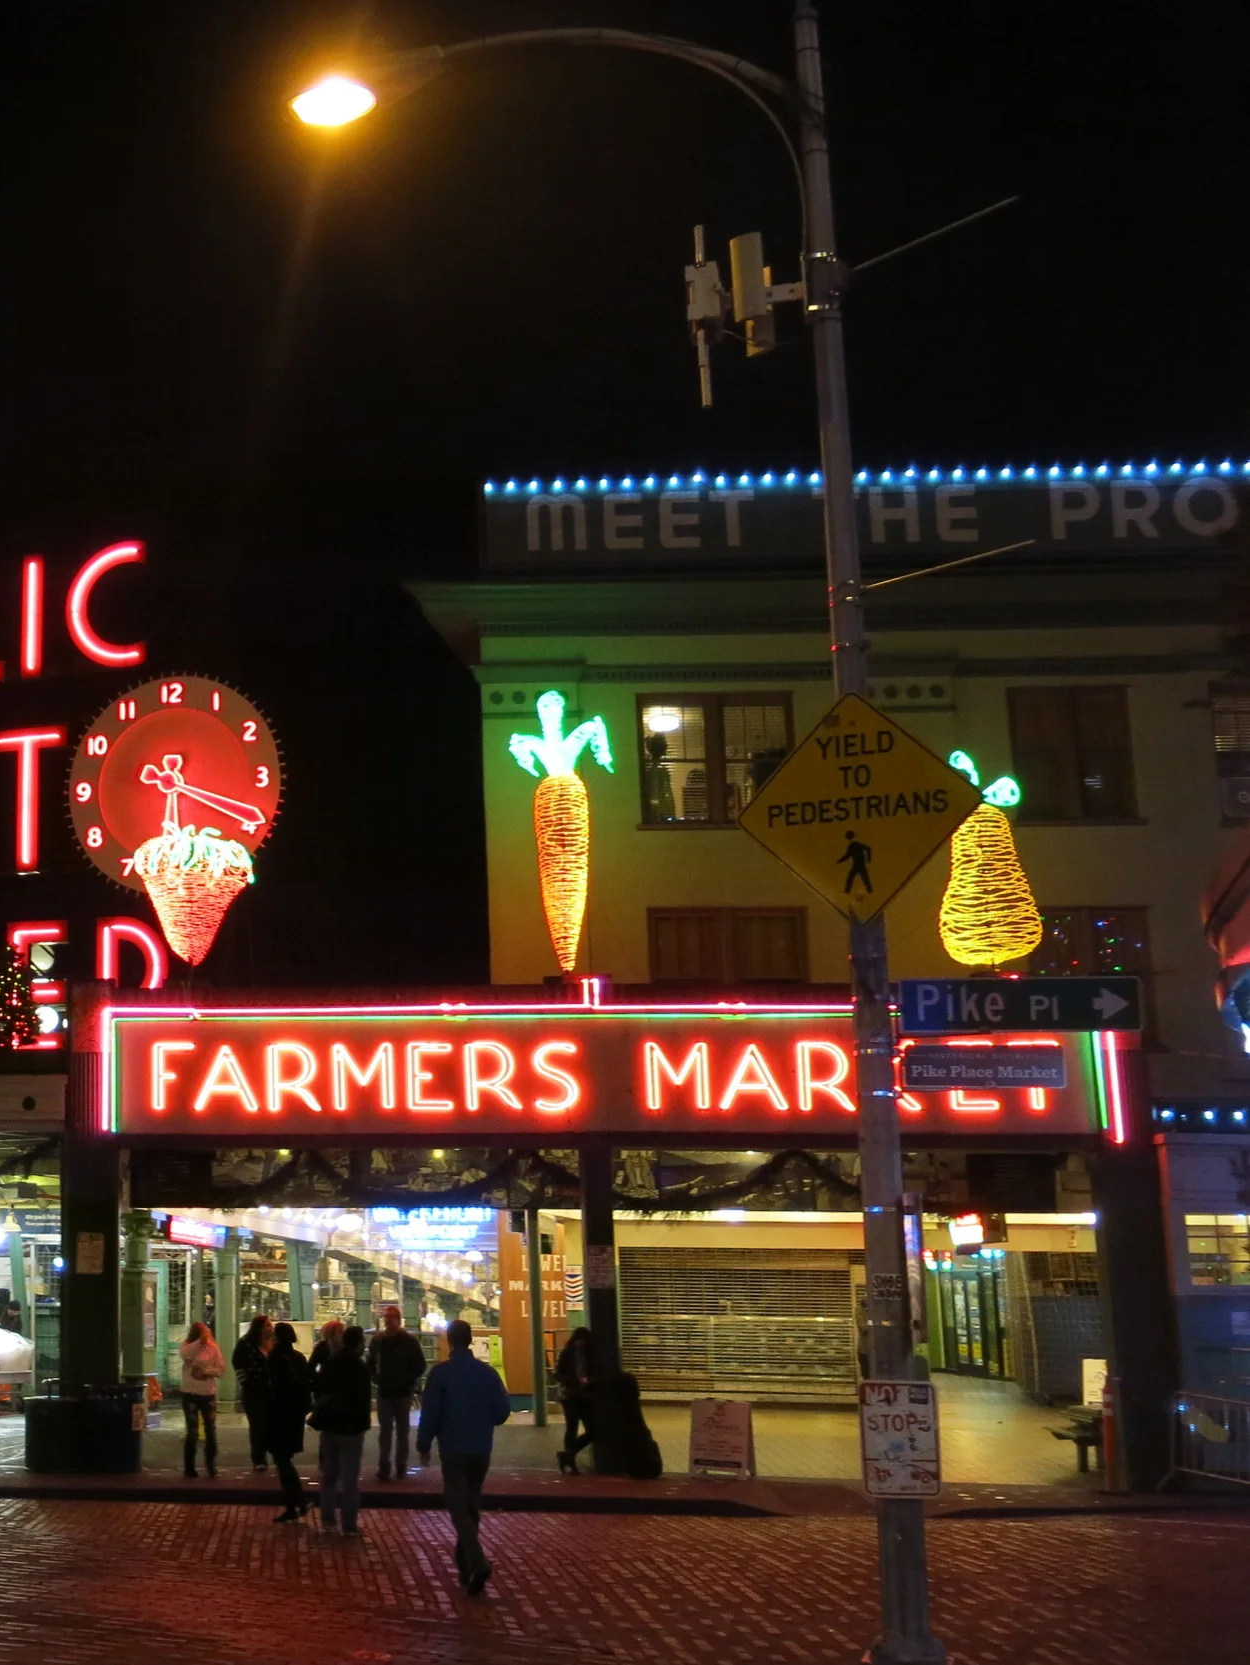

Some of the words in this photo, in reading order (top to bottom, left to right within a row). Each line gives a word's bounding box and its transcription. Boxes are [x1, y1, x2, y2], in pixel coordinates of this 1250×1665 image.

[525, 490, 755, 552] MEET
[813, 484, 980, 543] HE
[160, 682, 184, 704] 12
[211, 690, 221, 711] 1
[118, 700, 136, 721] 11
[242, 720, 258, 742] 2
[86, 735, 108, 756] 10
[814, 729, 895, 762] YIELD
[254, 765, 270, 788] 3
[838, 764, 872, 790] TO
[75, 782, 92, 803] 9
[767, 789, 950, 829] PEDESTRIANS
[86, 826, 103, 848] 8
[120, 857, 136, 877] 7
[915, 983, 1006, 1022] Pike
[1029, 995, 1059, 1021] Pl
[151, 1041, 580, 1113] FARMERS
[643, 1040, 1062, 1113] MARET
[910, 1065, 947, 1078] Pike
[950, 1066, 994, 1078] Place
[997, 1066, 1060, 1079] Market
[521, 1254, 567, 1272] LWE
[508, 1280, 564, 1291] MRK
[521, 1300, 567, 1318] LVEL
